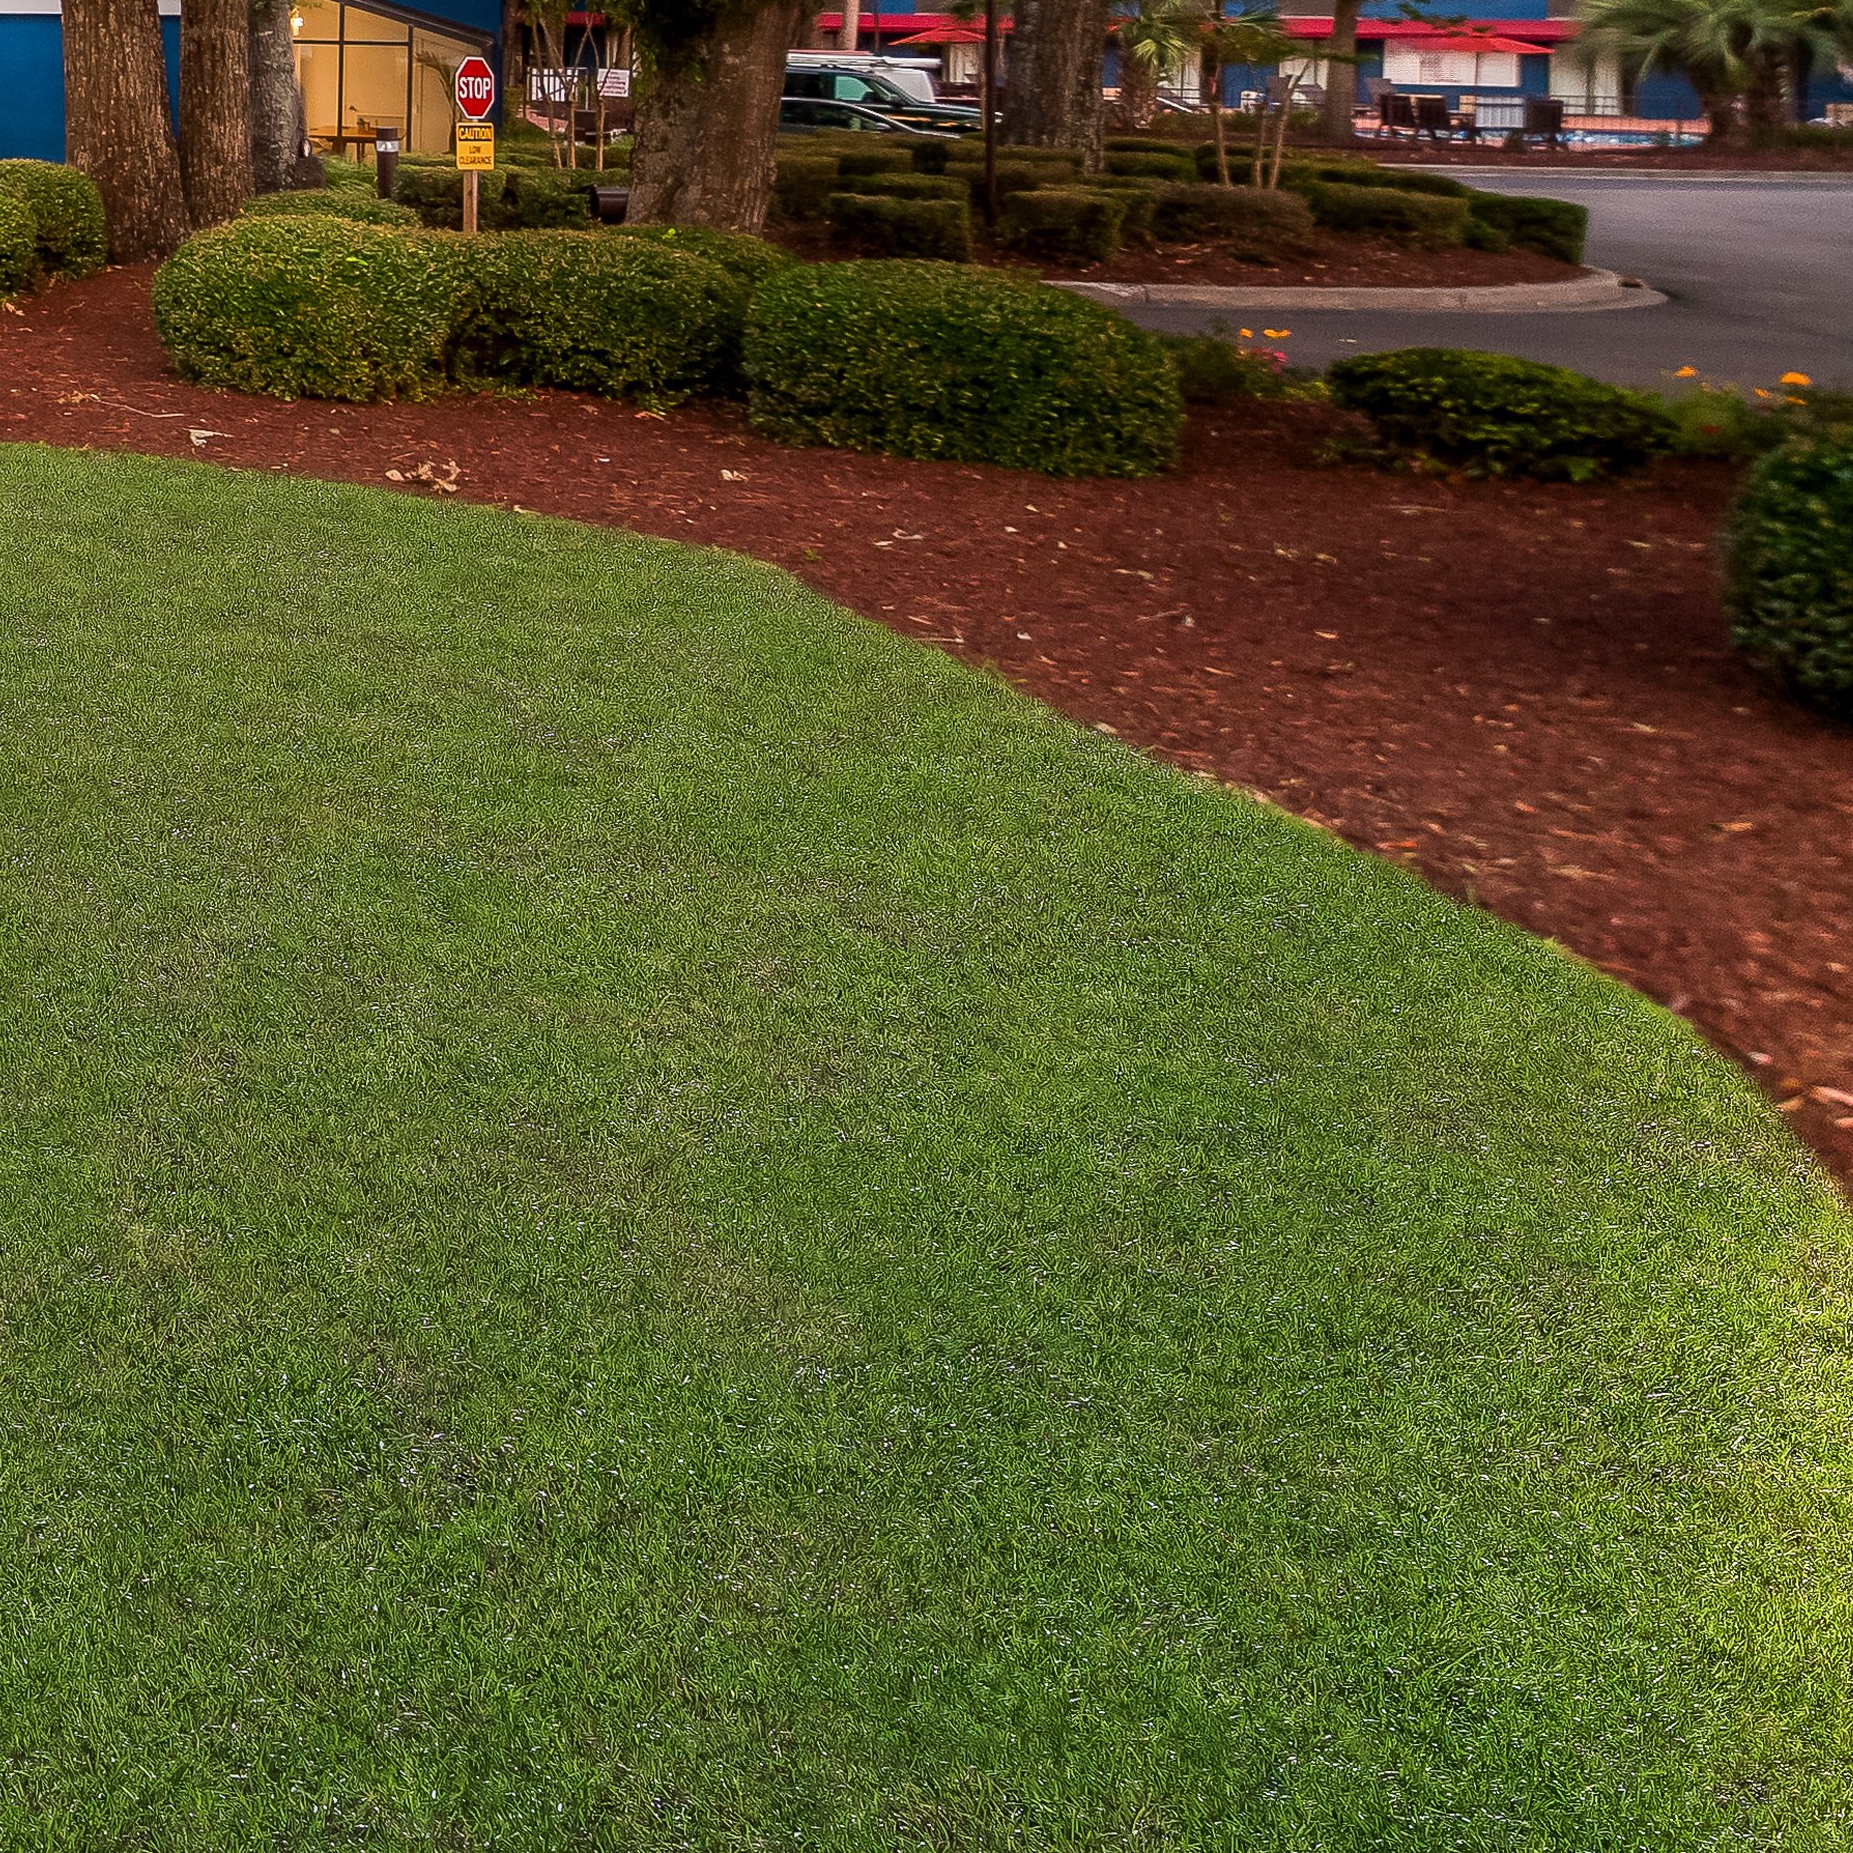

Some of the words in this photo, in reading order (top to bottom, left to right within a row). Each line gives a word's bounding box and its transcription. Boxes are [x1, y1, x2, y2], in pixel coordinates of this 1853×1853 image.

[459, 76, 491, 99] STOP
[459, 127, 493, 140] CAUTION
[459, 155, 492, 165] CLEARANCE
